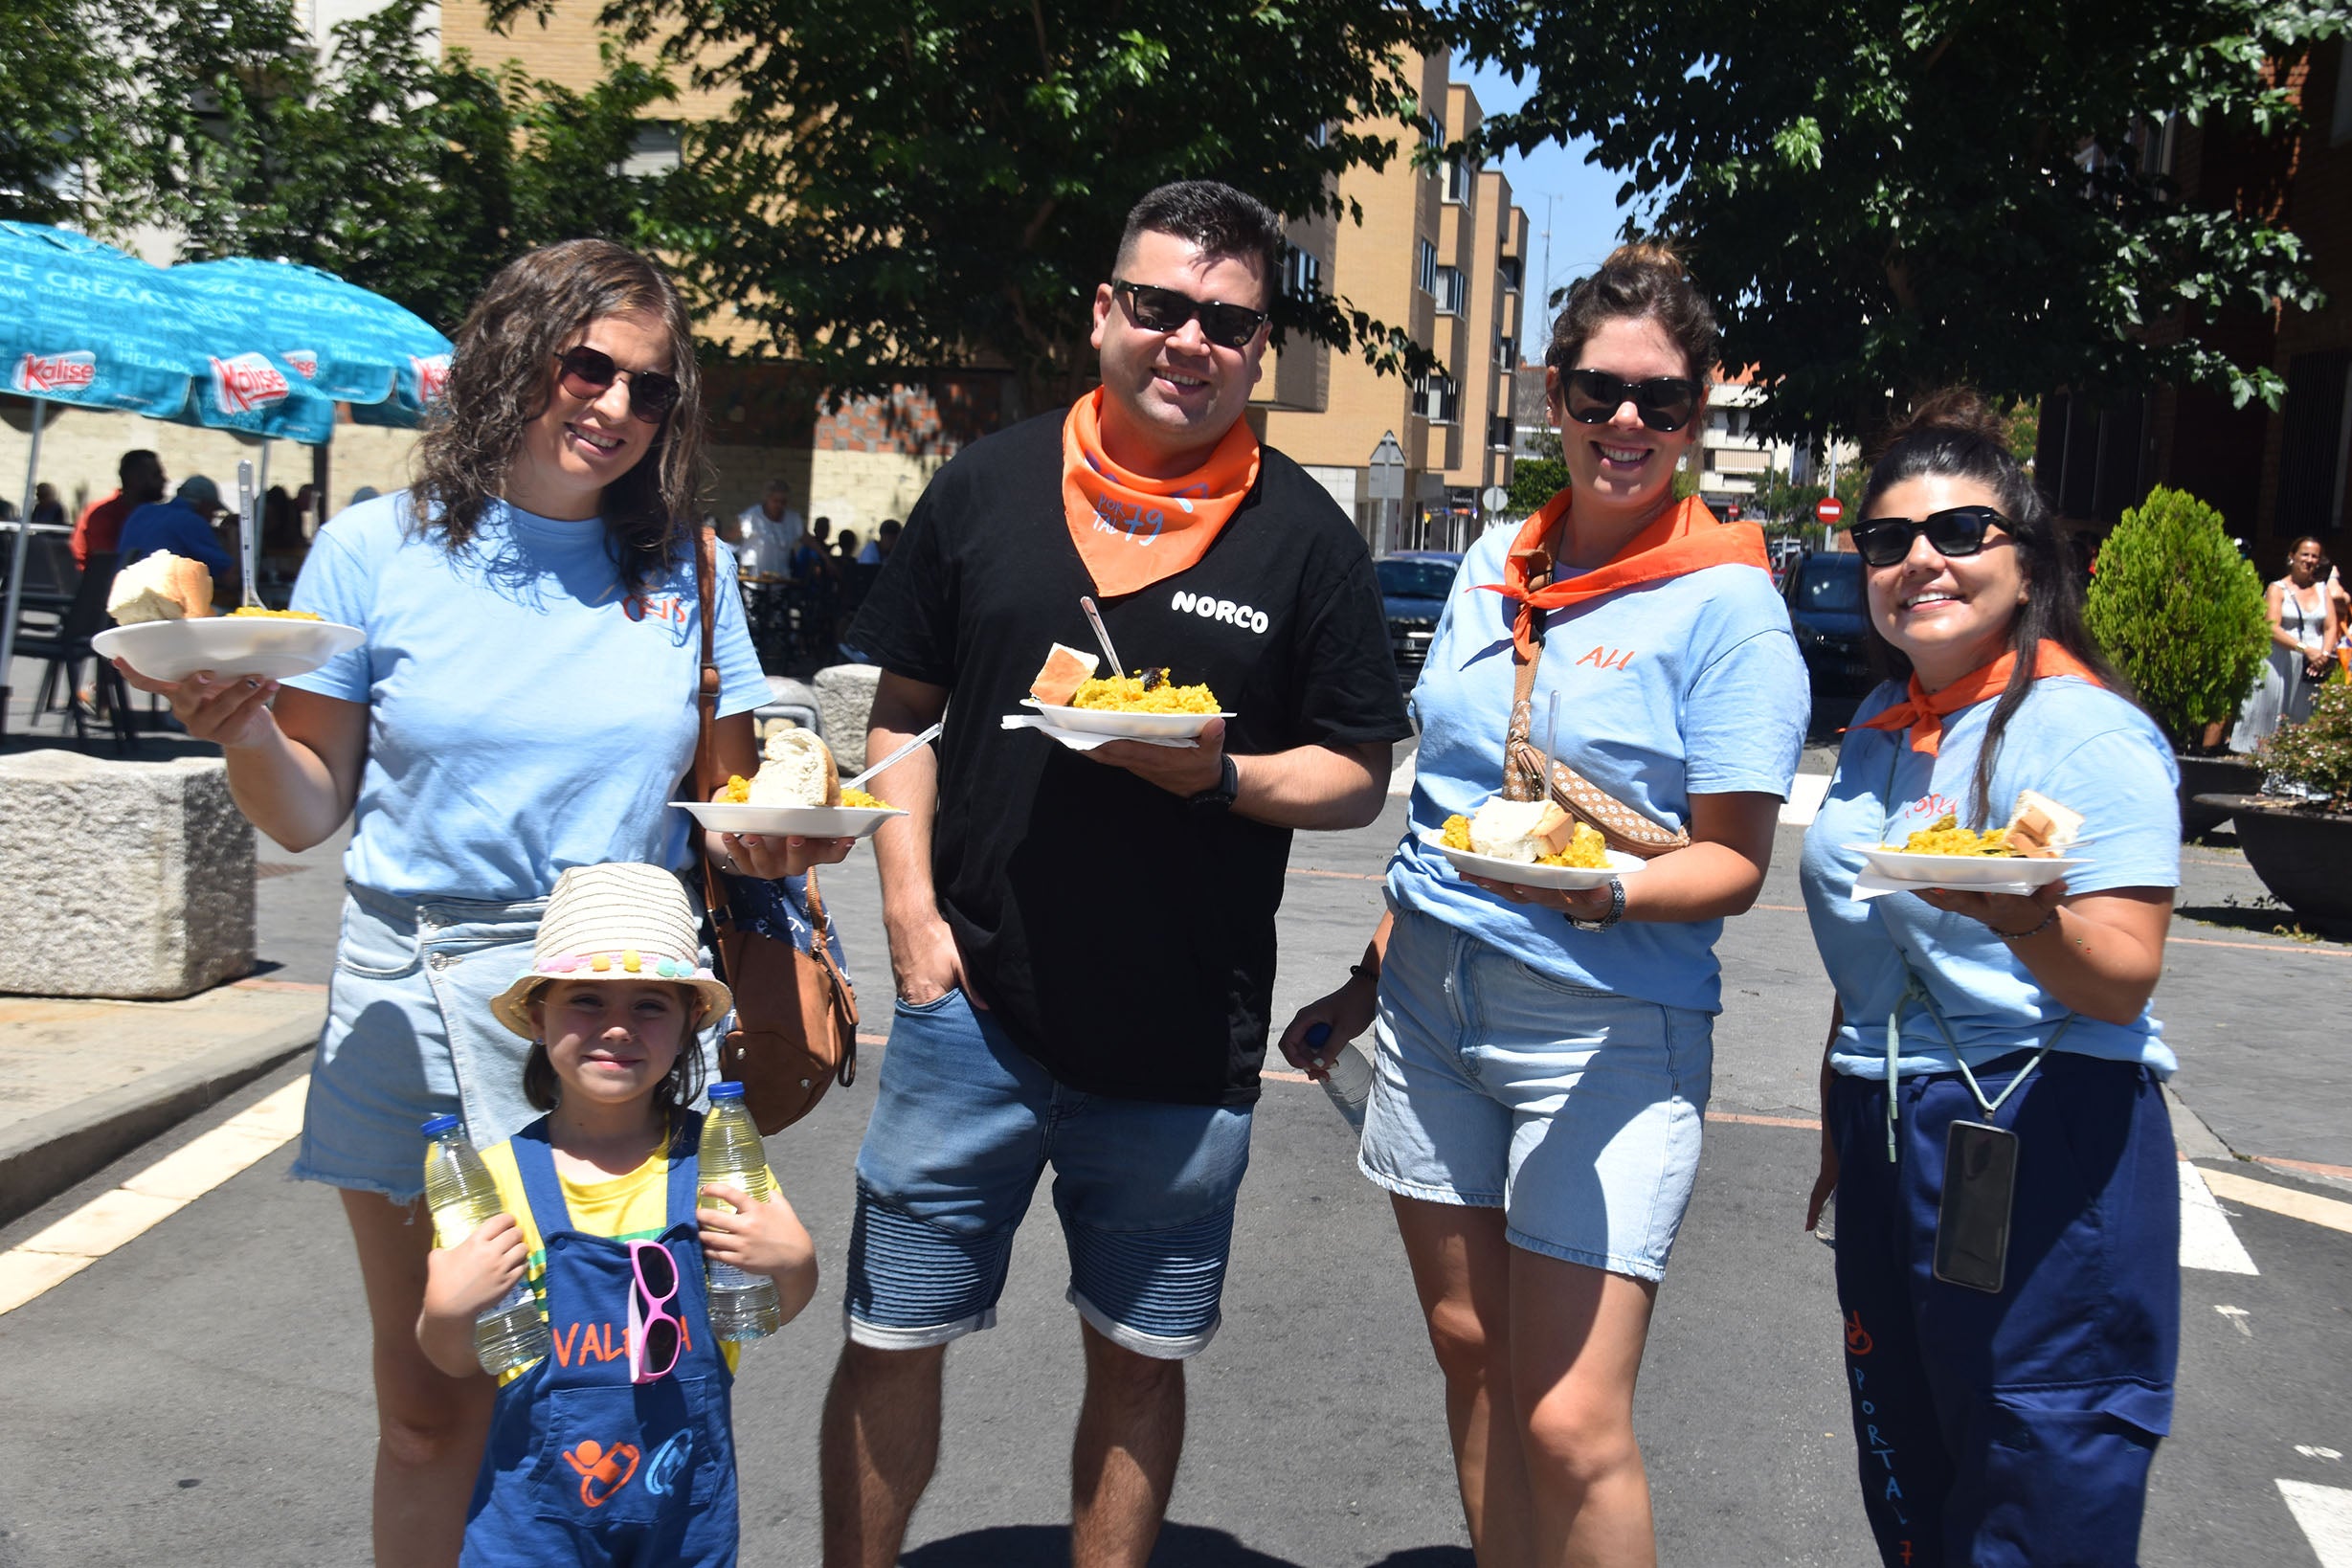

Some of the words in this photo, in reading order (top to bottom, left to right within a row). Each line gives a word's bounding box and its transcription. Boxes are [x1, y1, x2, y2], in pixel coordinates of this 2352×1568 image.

[24, 353, 95, 391] Kalise
[212, 358, 284, 414] Kalise
[1093, 509, 1119, 535] TAL
[1097, 491, 1126, 518] POR
[1124, 503, 1164, 547] 79
[1171, 590, 1269, 634] NORCO
[1575, 646, 1635, 671] ALI
